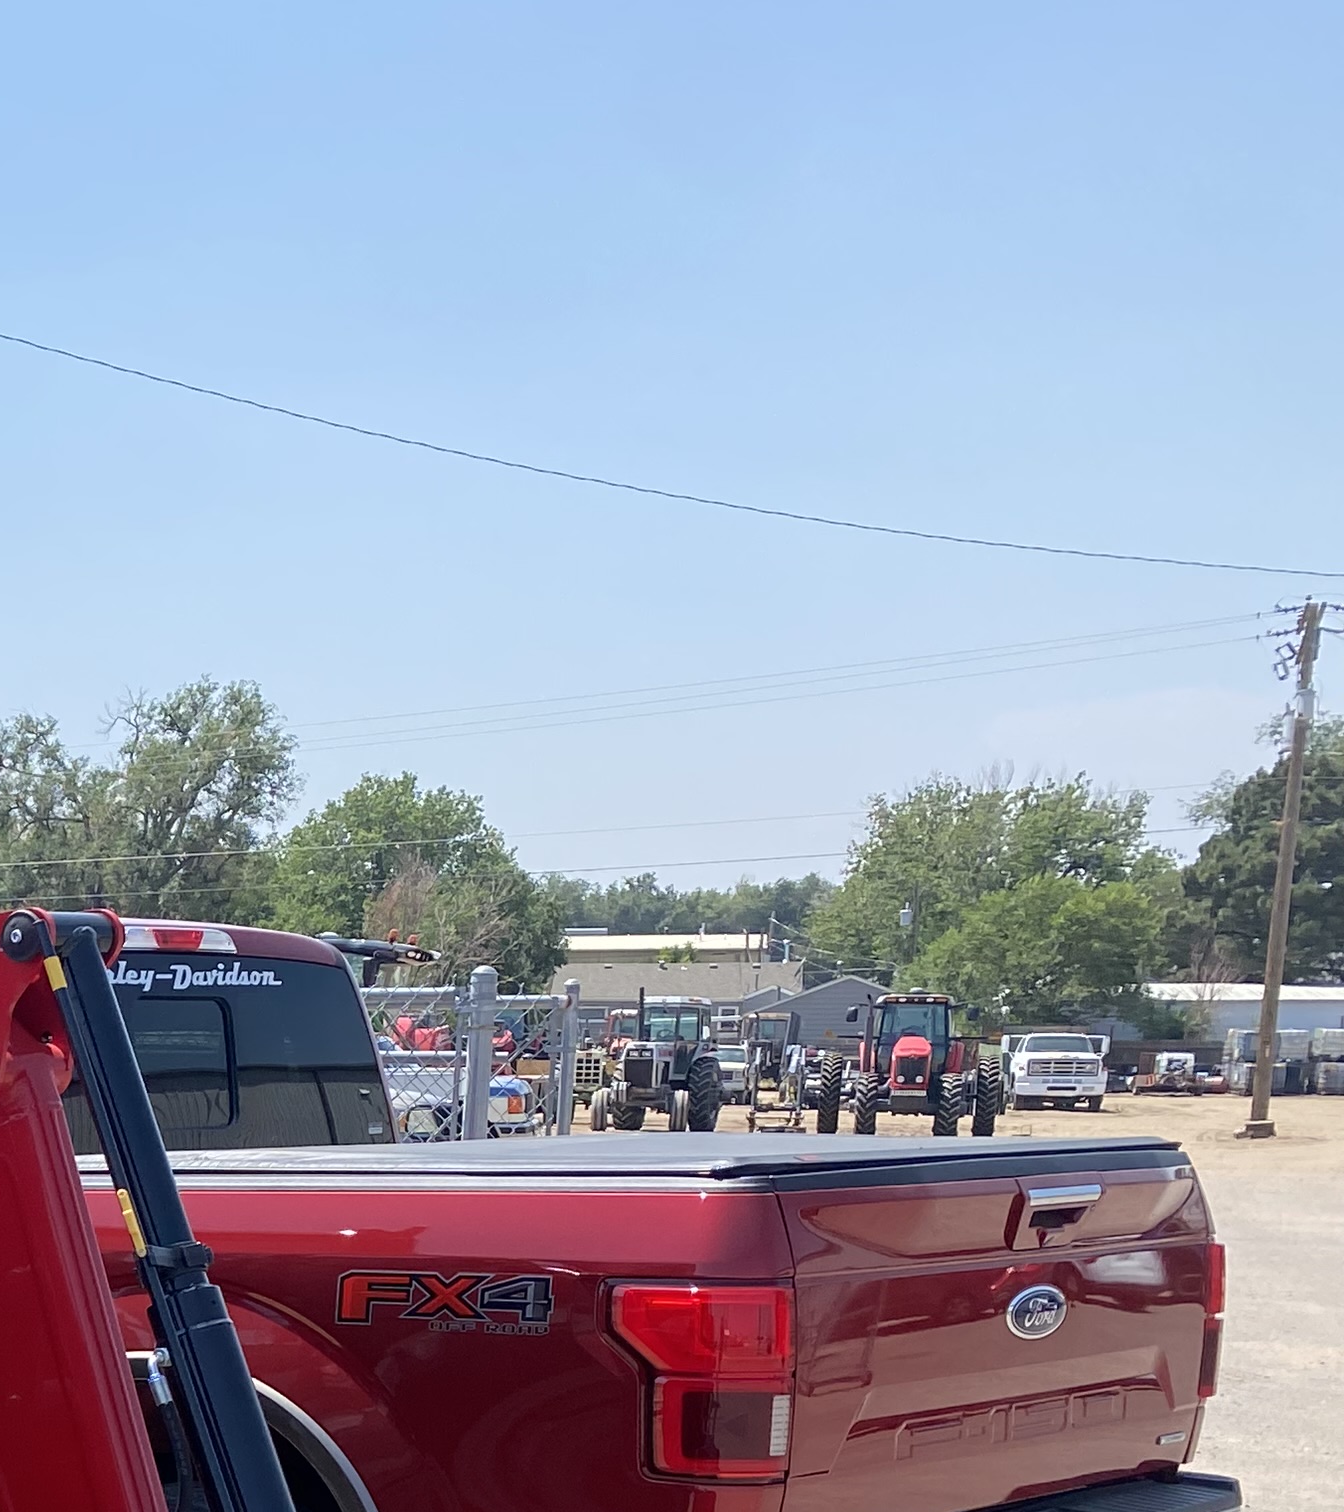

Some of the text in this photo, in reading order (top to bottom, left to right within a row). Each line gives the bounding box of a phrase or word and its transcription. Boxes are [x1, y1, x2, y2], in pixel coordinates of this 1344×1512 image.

[107, 961, 283, 992] ley-Davidson
[335, 1269, 555, 1326] FX4
[1023, 1297, 1059, 1328] Ford
[428, 1321, 551, 1336] OFF ROAD
[895, 1386, 1128, 1461] F-150
